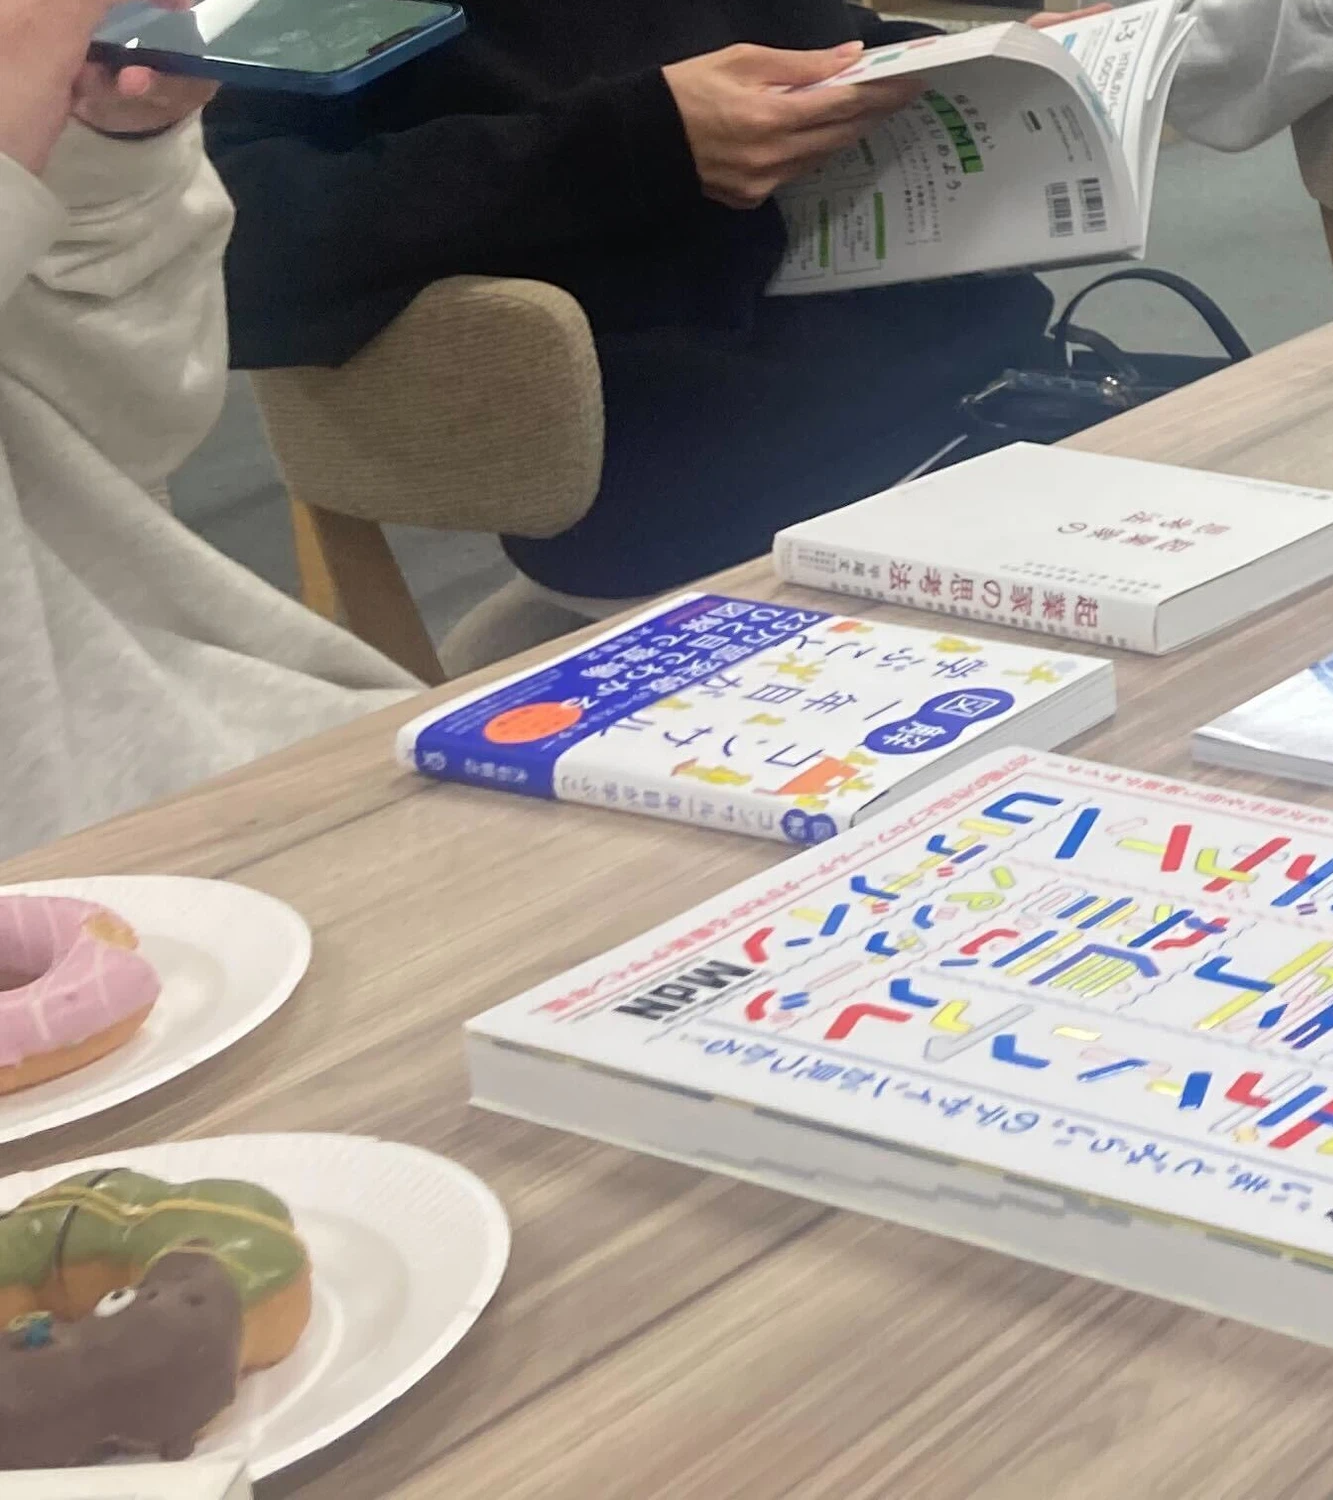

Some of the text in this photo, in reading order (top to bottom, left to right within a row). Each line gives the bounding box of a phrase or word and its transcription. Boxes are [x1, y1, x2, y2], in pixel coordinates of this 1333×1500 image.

[888, 559, 1101, 628] 起業家の思考法
[554, 606, 785, 711] ひと目でわかる
[637, 611, 821, 694] 23万部突破
[766, 629, 994, 681] 学ぶこと
[682, 669, 905, 724] 一年目が
[872, 692, 1004, 751] 図解
[602, 716, 830, 768] コンサル
[608, 958, 758, 1024] MdN
